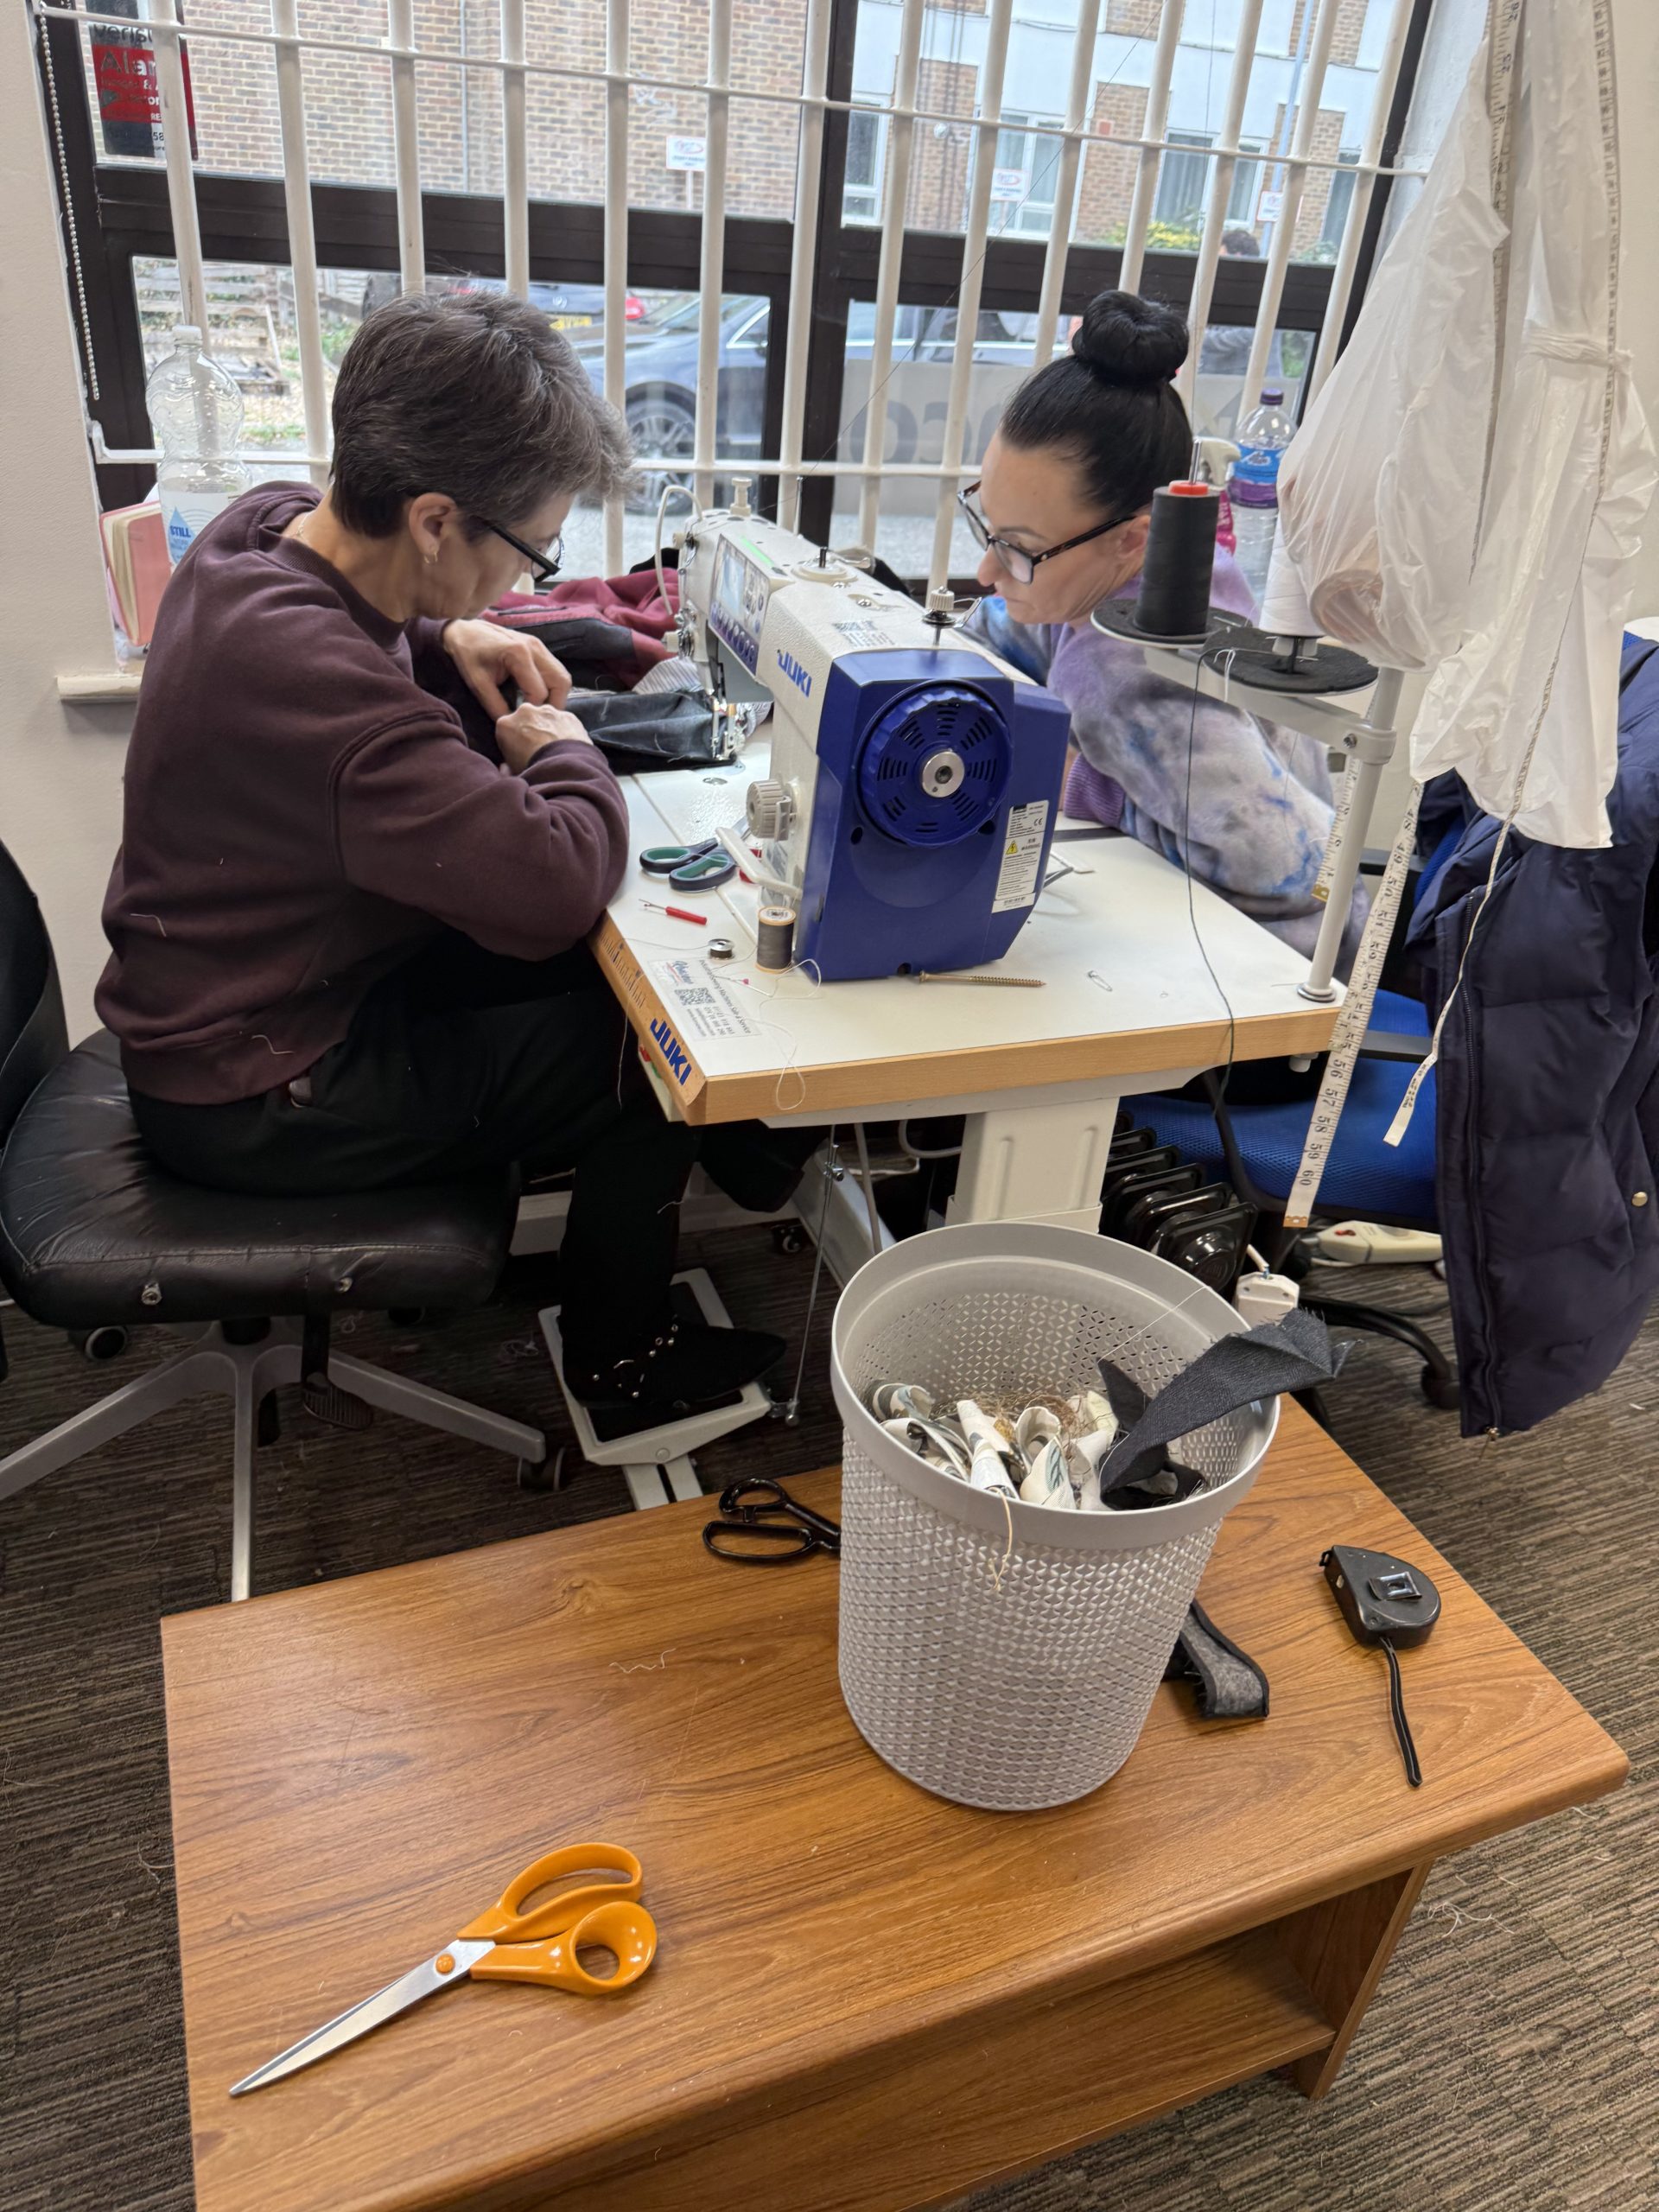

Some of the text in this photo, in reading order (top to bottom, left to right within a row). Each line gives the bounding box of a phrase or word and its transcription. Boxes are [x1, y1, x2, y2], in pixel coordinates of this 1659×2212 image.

[101, 50, 156, 76] Alar
[169, 525, 191, 537] STILL
[778, 651, 812, 698] JUKI
[650, 1018, 692, 1086] JUKI
[1330, 1058, 1346, 1079] 56
[1322, 1088, 1338, 1107] 57
[1314, 1116, 1331, 1134] 58
[1307, 1143, 1323, 1160] 59
[1300, 1169, 1315, 1186] 60
